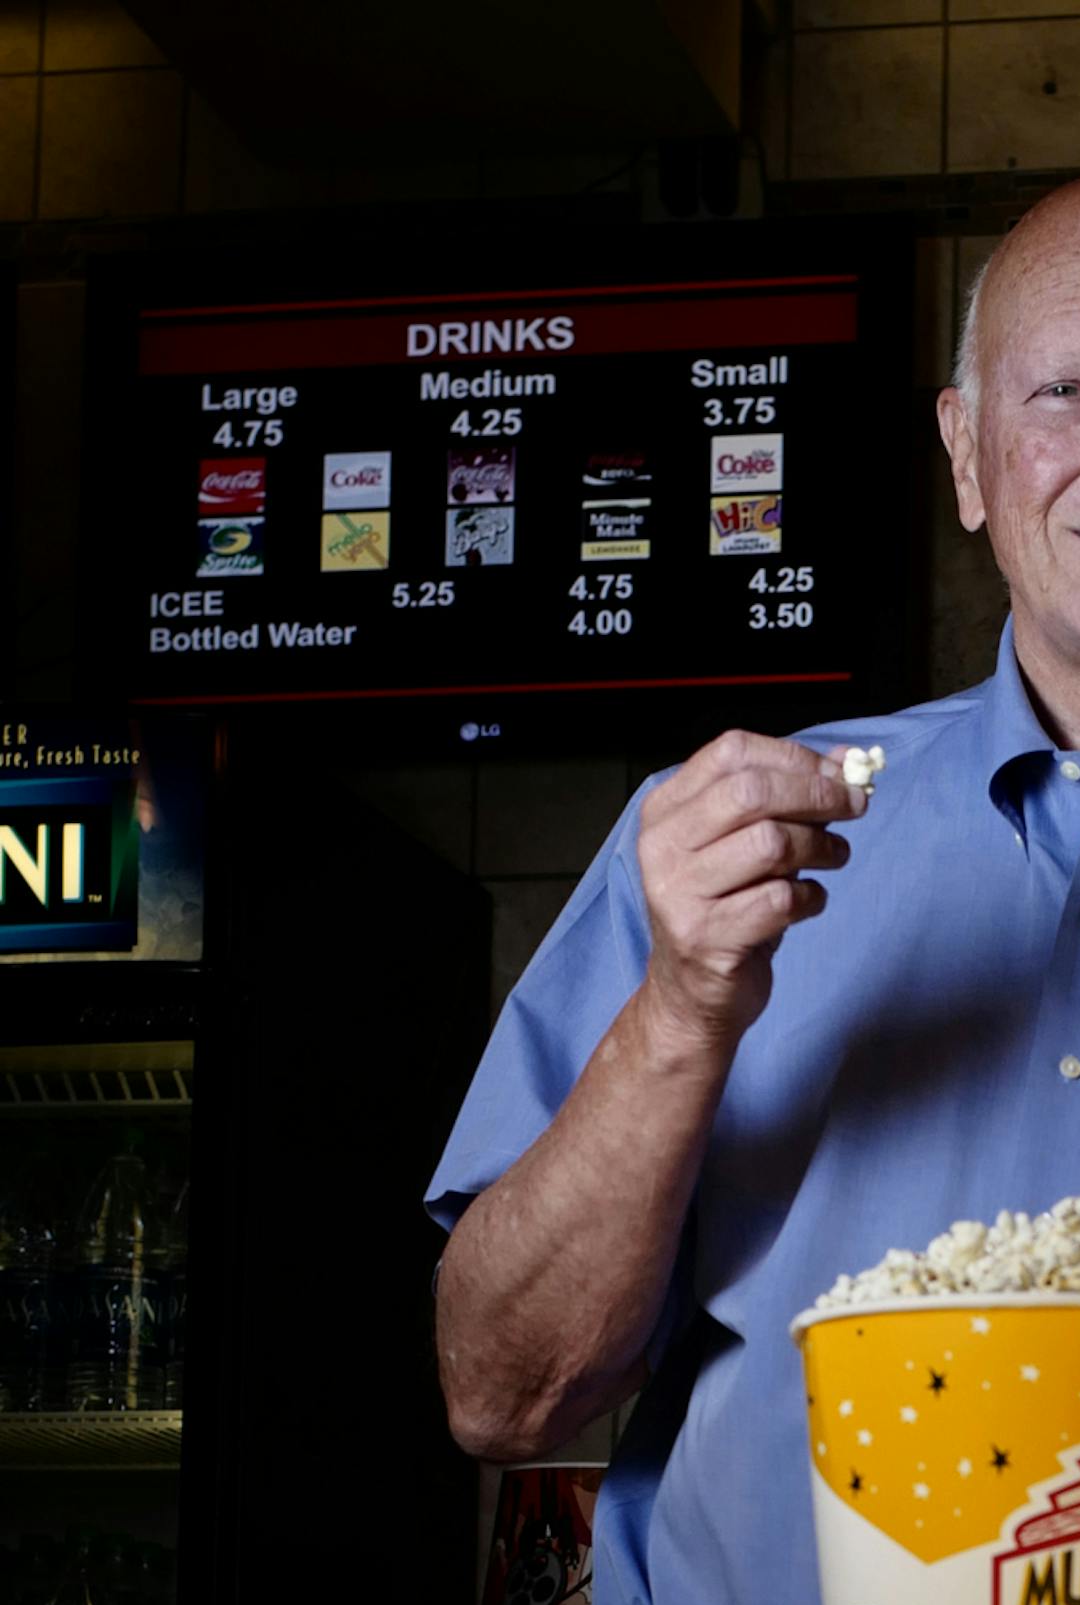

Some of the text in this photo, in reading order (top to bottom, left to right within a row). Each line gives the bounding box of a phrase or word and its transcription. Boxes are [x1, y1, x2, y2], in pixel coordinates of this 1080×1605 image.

[406, 317, 575, 357] DRINKS
[420, 369, 556, 400] Medium
[690, 356, 789, 388] Small
[201, 383, 298, 415] Large
[703, 396, 776, 427] 3.75
[213, 419, 284, 449] 4.75
[450, 408, 523, 437] 4.25
[330, 467, 385, 489] Coke
[716, 453, 776, 476] Coke
[589, 512, 645, 526] Minute
[596, 524, 637, 538] Maid
[150, 566, 815, 618] ICEE 5.25 4.75 4.25
[150, 602, 814, 653] Bottled Water 4.00 3.50
[480, 722, 501, 737] LG
[36, 745, 85, 767] Fresh
[92, 744, 142, 765] Taste
